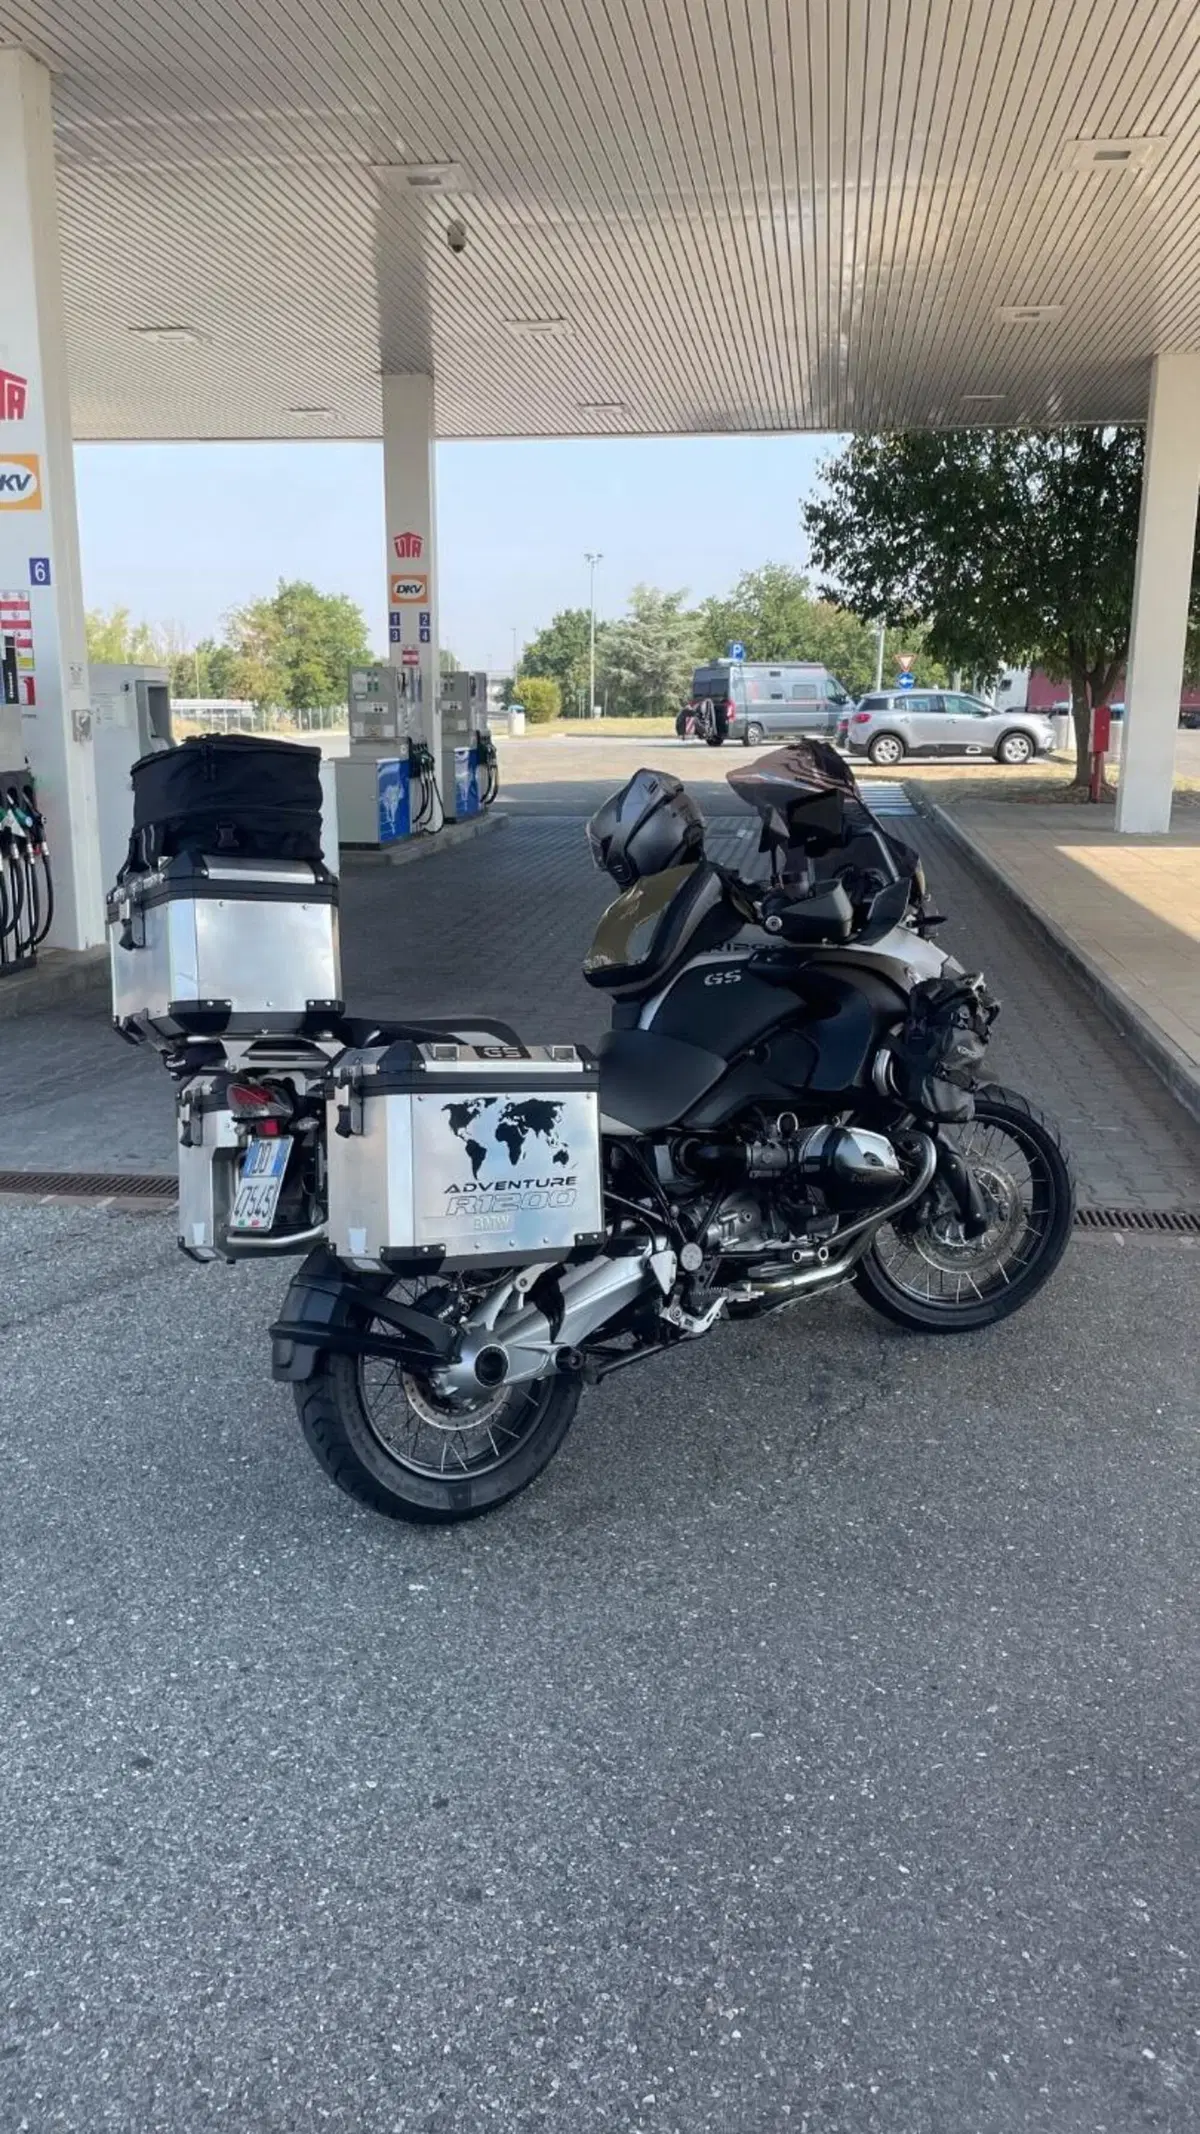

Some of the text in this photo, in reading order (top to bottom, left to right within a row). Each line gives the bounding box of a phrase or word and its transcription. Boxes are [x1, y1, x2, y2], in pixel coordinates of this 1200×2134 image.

[0, 367, 27, 420] TA
[0, 474, 32, 491] KV
[394, 531, 424, 558] UTA
[34, 562, 46, 582] 6
[396, 584, 423, 594] DKV
[421, 613, 428, 625] 2
[391, 630, 398, 641] 3
[421, 629, 428, 641] 4
[732, 643, 742, 659] P
[704, 968, 742, 986] GS
[483, 1047, 522, 1058] GS
[444, 1176, 579, 1194] ADVENTURE
[445, 1188, 578, 1216] R1200
